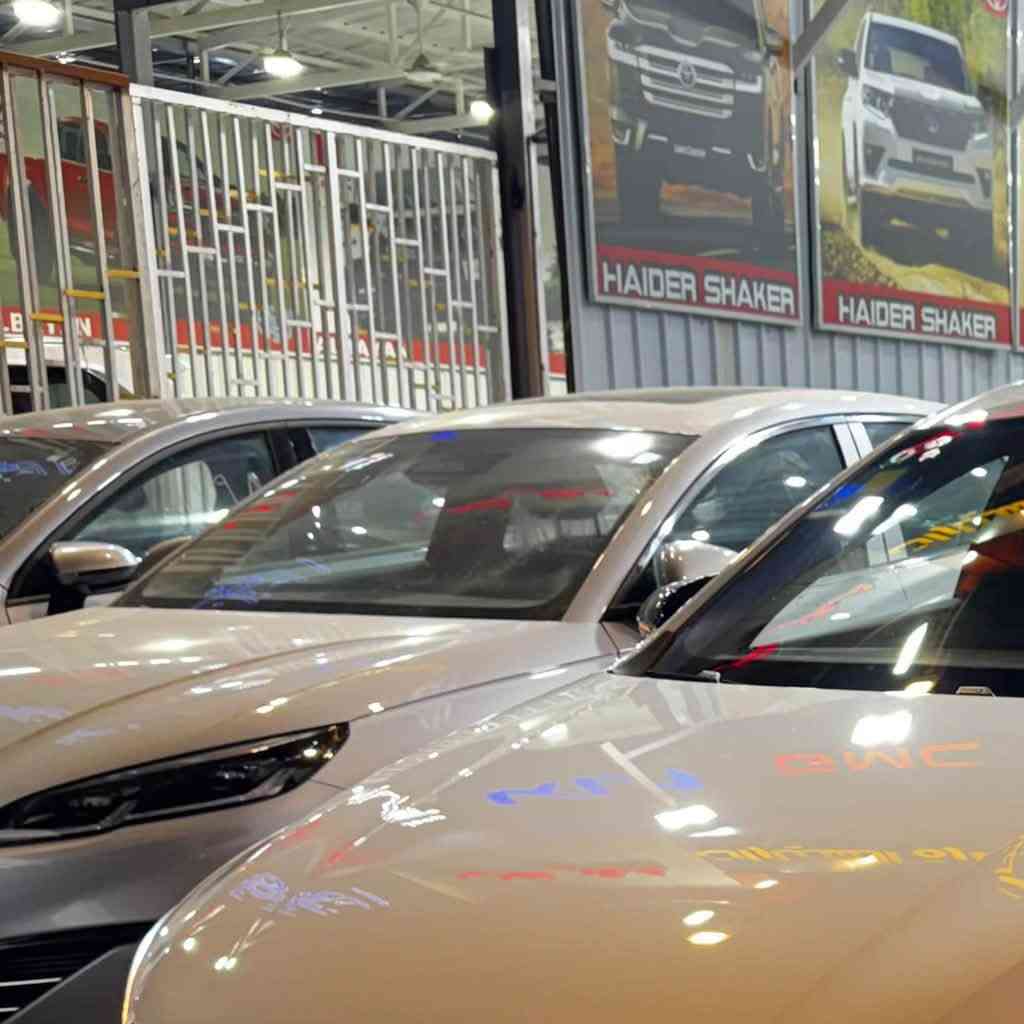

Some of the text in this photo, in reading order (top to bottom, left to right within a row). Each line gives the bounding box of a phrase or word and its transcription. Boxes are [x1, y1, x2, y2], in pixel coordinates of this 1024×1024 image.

[602, 261, 796, 316] HAIDER SHAKER
[838, 295, 997, 340] HAIDER SHAKER
